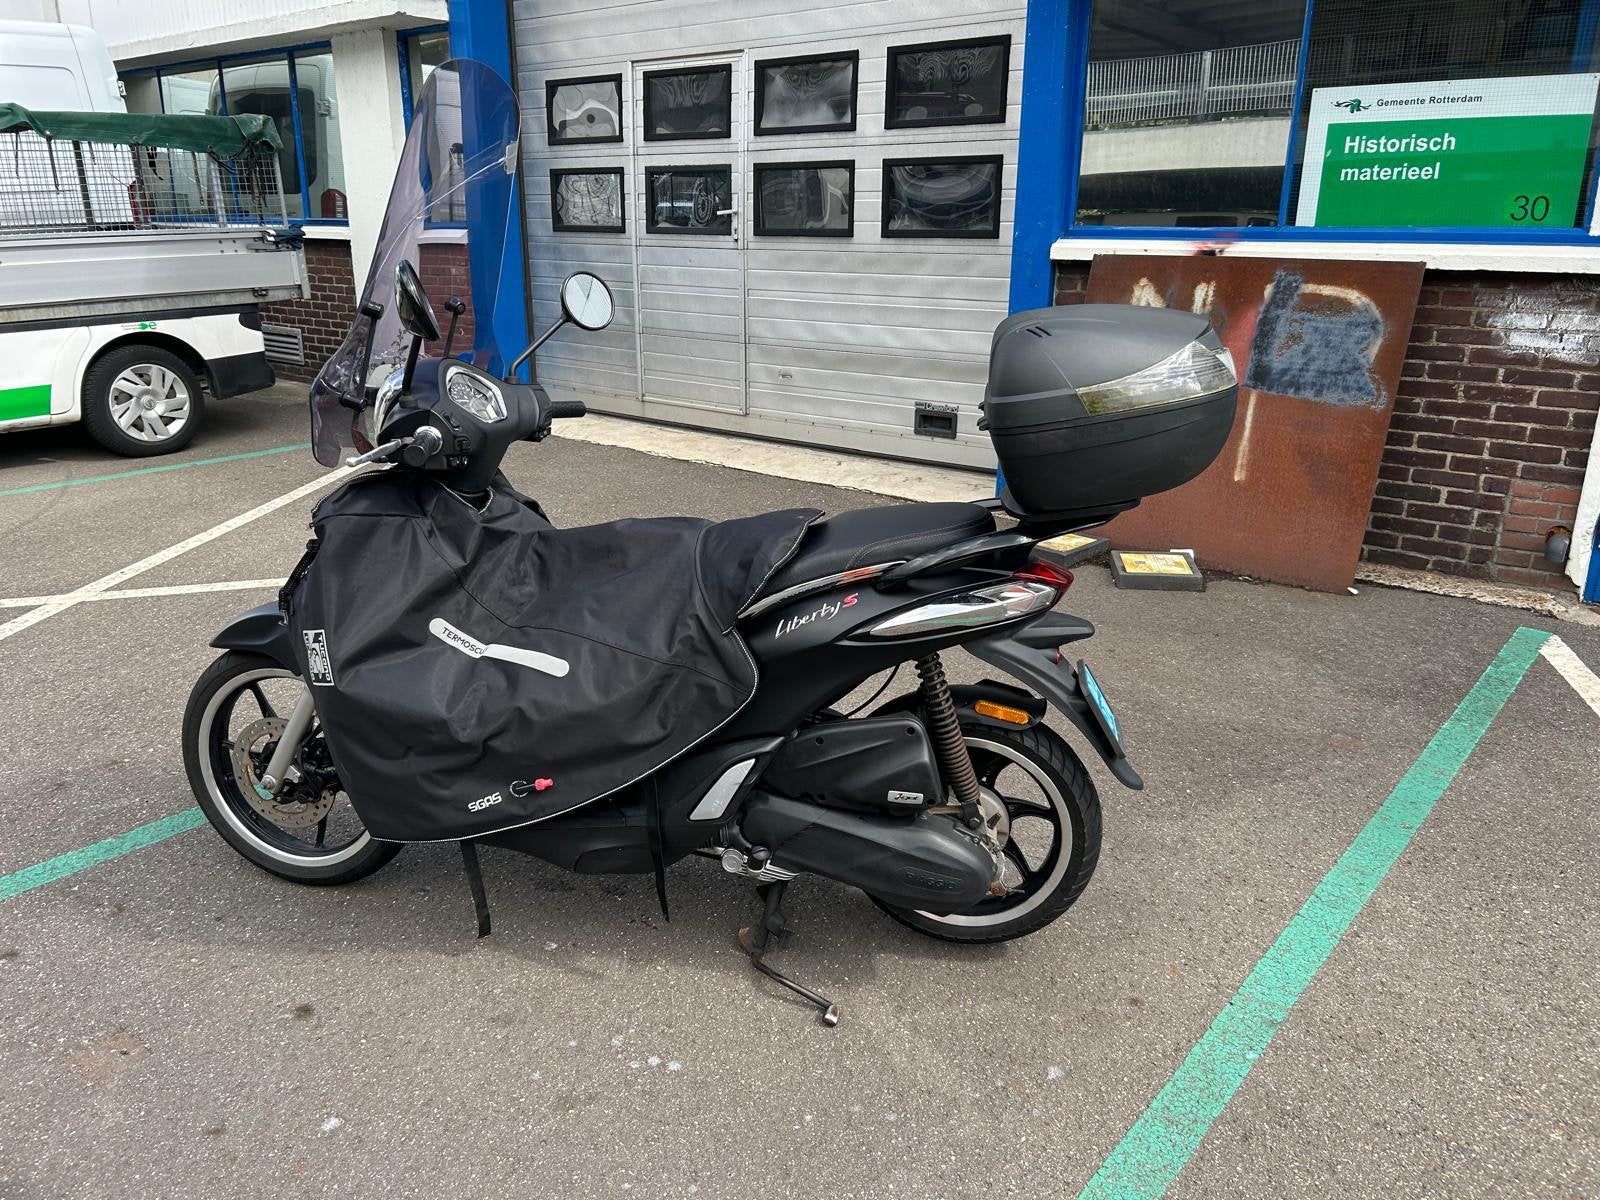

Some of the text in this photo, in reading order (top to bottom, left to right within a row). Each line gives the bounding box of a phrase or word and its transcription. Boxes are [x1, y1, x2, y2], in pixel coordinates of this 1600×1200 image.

[1376, 94, 1483, 107] Gemeente Rotterdam
[1344, 132, 1456, 154] Historisch
[1340, 162, 1441, 181] materieel
[1510, 194, 1550, 222] 30
[775, 592, 859, 639] Liberty S
[442, 626, 488, 655] TERMOSCU
[467, 792, 503, 813] SGAS
